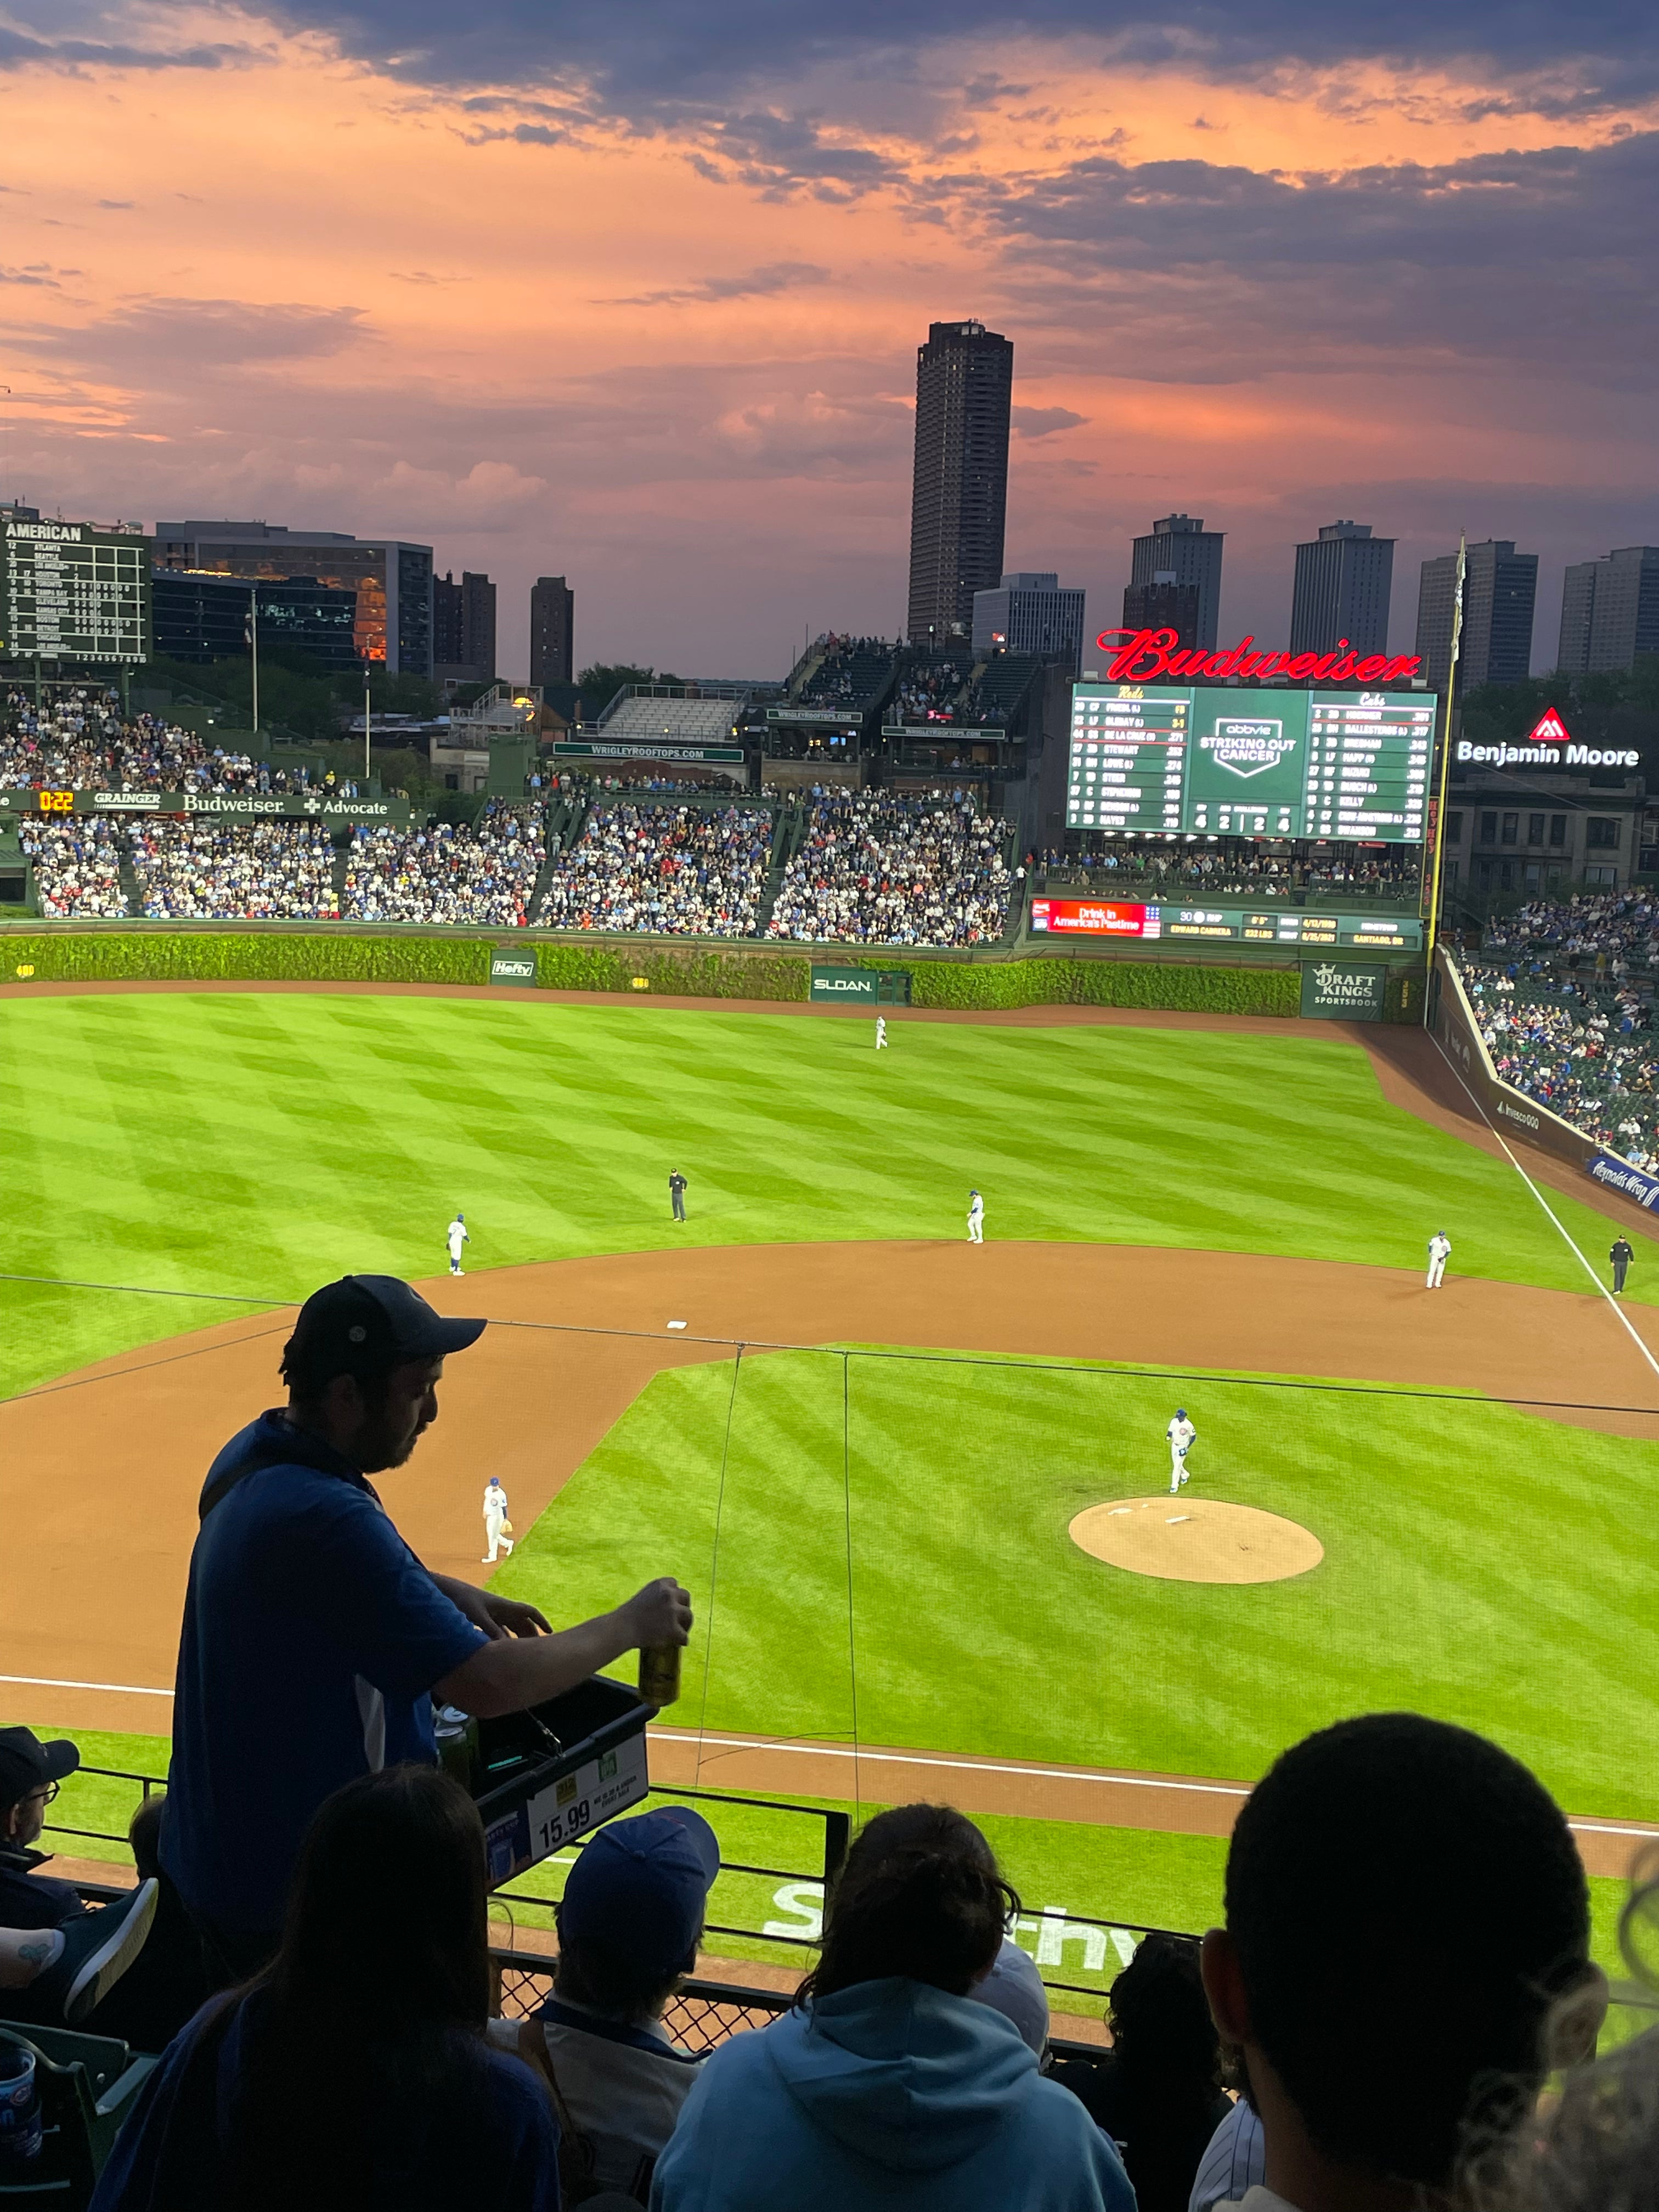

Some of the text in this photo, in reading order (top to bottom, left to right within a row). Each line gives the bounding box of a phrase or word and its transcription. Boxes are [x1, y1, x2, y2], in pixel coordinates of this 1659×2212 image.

[5, 523, 81, 541] AMERICAN
[1097, 628, 1421, 681] Budweiser
[1118, 686, 1144, 699] Reds
[1359, 692, 1386, 707] Cubs
[1226, 725, 1271, 735] abbvie
[1200, 737, 1296, 751] STRIKING OUT
[591, 745, 703, 758] WRIGLEYROOFTOPS.COM
[1220, 749, 1274, 760] CANCER
[1457, 741, 1640, 767] Benjamin Moore
[40, 791, 74, 811] 0:22
[94, 793, 160, 804] GRAINGER
[183, 794, 283, 812] Budweiser
[324, 800, 388, 815] Advocate
[1195, 814, 1206, 828] 4
[1219, 815, 1229, 830] 2
[1254, 817, 1265, 831] 2
[1278, 818, 1289, 832] 4
[1079, 908, 1116, 919] Drink in
[1180, 912, 1192, 922] 30
[1053, 916, 1099, 928] America's
[1102, 918, 1139, 930] Pastime
[495, 962, 531, 974] Hefty
[814, 979, 870, 991] SLOAN
[1316, 973, 1376, 986] DRAFT
[1322, 986, 1372, 997] KINGS
[1314, 997, 1378, 1007] SPORTSBOOK
[1592, 1161, 1648, 1201] Reynolds Wrap
[539, 1799, 590, 1849] 15.99
